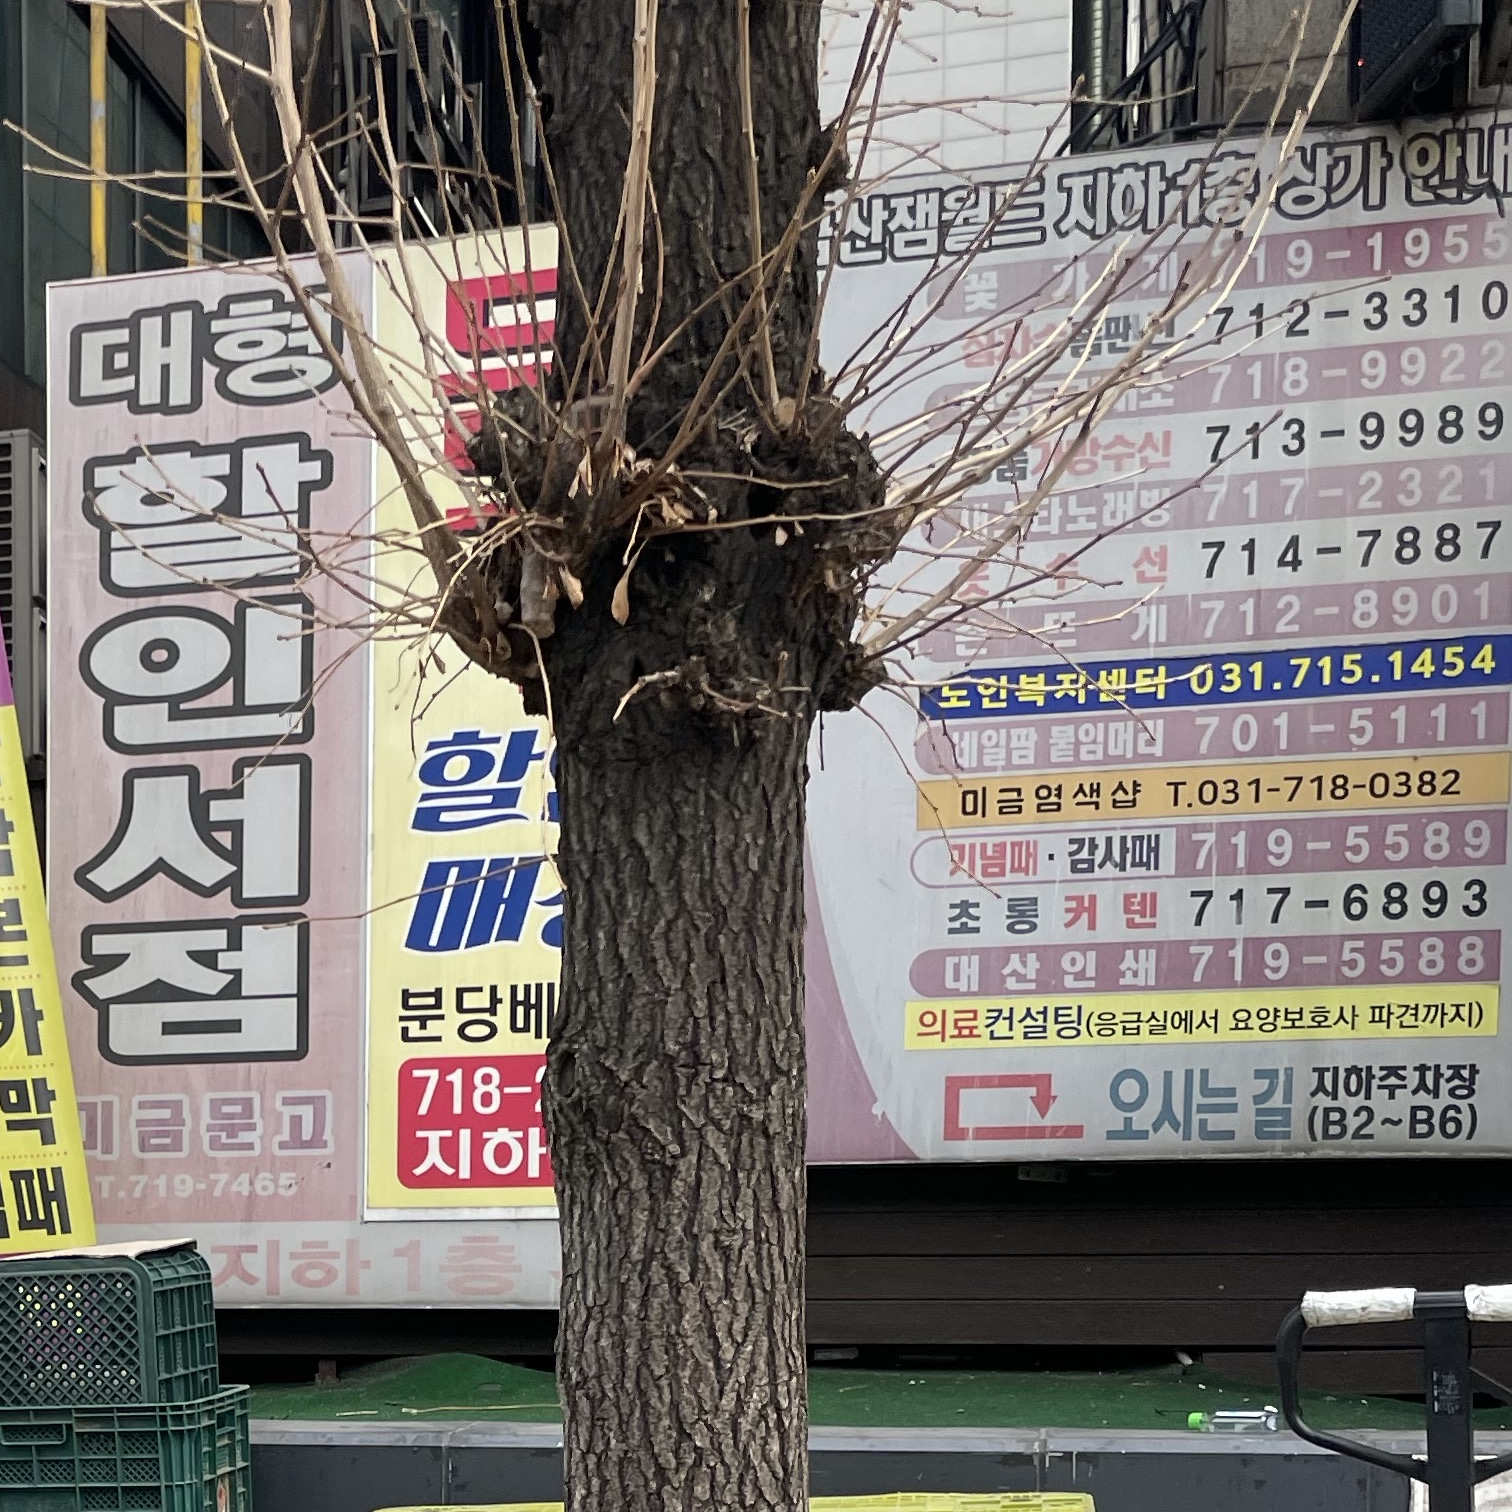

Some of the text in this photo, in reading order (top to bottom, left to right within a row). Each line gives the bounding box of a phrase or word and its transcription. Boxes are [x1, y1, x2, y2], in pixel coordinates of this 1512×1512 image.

[1275, 136, 1393, 221] 상가
[1210, 220, 1510, 291] 719-1955
[1211, 280, 1509, 345] 712-3310
[69, 285, 343, 415] 대형
[1206, 338, 1506, 405] 718-9922
[1205, 401, 1504, 464] 713-9989
[1202, 460, 1497, 522] 717-2321
[1200, 520, 1502, 579] 714-7887
[1199, 581, 1490, 639] 712-8901
[938, 643, 1496, 709] 노인복지센터 031.715.1454
[1194, 700, 1488, 755] 701-5111
[410, 729, 559, 833] 할
[961, 768, 1462, 818] 미금염색샵 T.031-718-0382
[948, 819, 1491, 878] 기념패 감사패 719-5589
[1189, 878, 1489, 927] 717-6893
[945, 935, 1486, 993] 대산인쇄 719-5588
[1229, 1006, 1359, 1033] 요양보호사
[1368, 999, 1484, 1030] 파견까지)
[1310, 1062, 1480, 1101] 지하주차장
[1308, 1102, 1478, 1142] (B2~B6)
[94, 1171, 299, 1199] T.719-7465
